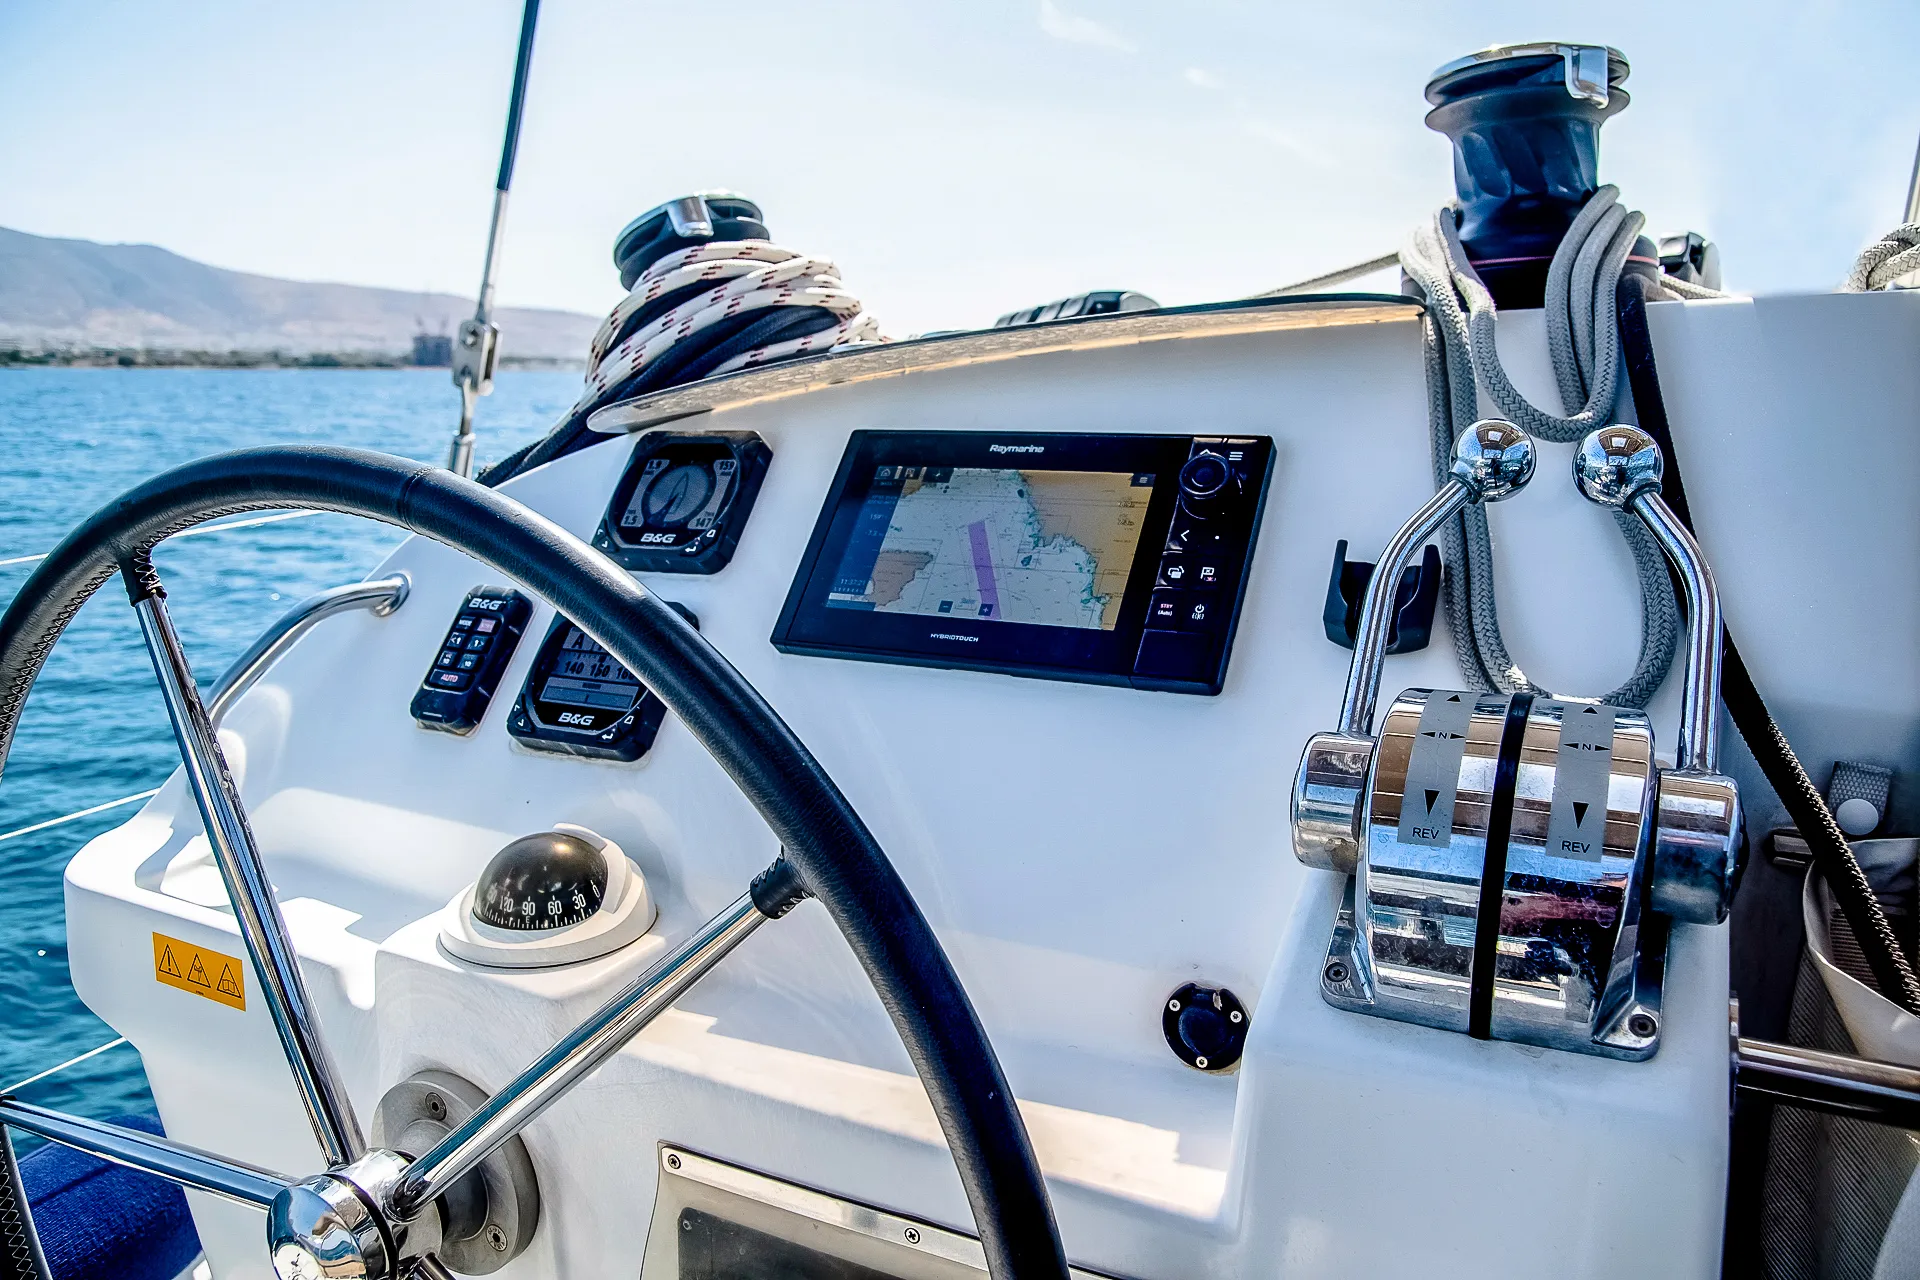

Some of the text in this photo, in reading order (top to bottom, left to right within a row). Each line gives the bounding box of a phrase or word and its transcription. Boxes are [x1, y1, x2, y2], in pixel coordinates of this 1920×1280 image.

[989, 444, 1045, 455] Raymarine
[640, 533, 677, 544] B&G
[468, 597, 503, 611] B&G
[930, 633, 979, 643] HYBRIDTOUCH
[563, 660, 585, 675] 140
[557, 711, 595, 726] B&G
[1438, 731, 1448, 740] N
[1582, 743, 1592, 751] N
[1412, 827, 1440, 840] REV
[1561, 840, 1591, 854] REV
[521, 901, 536, 916] 90
[547, 900, 563, 916] 60
[572, 893, 587, 910] 30
